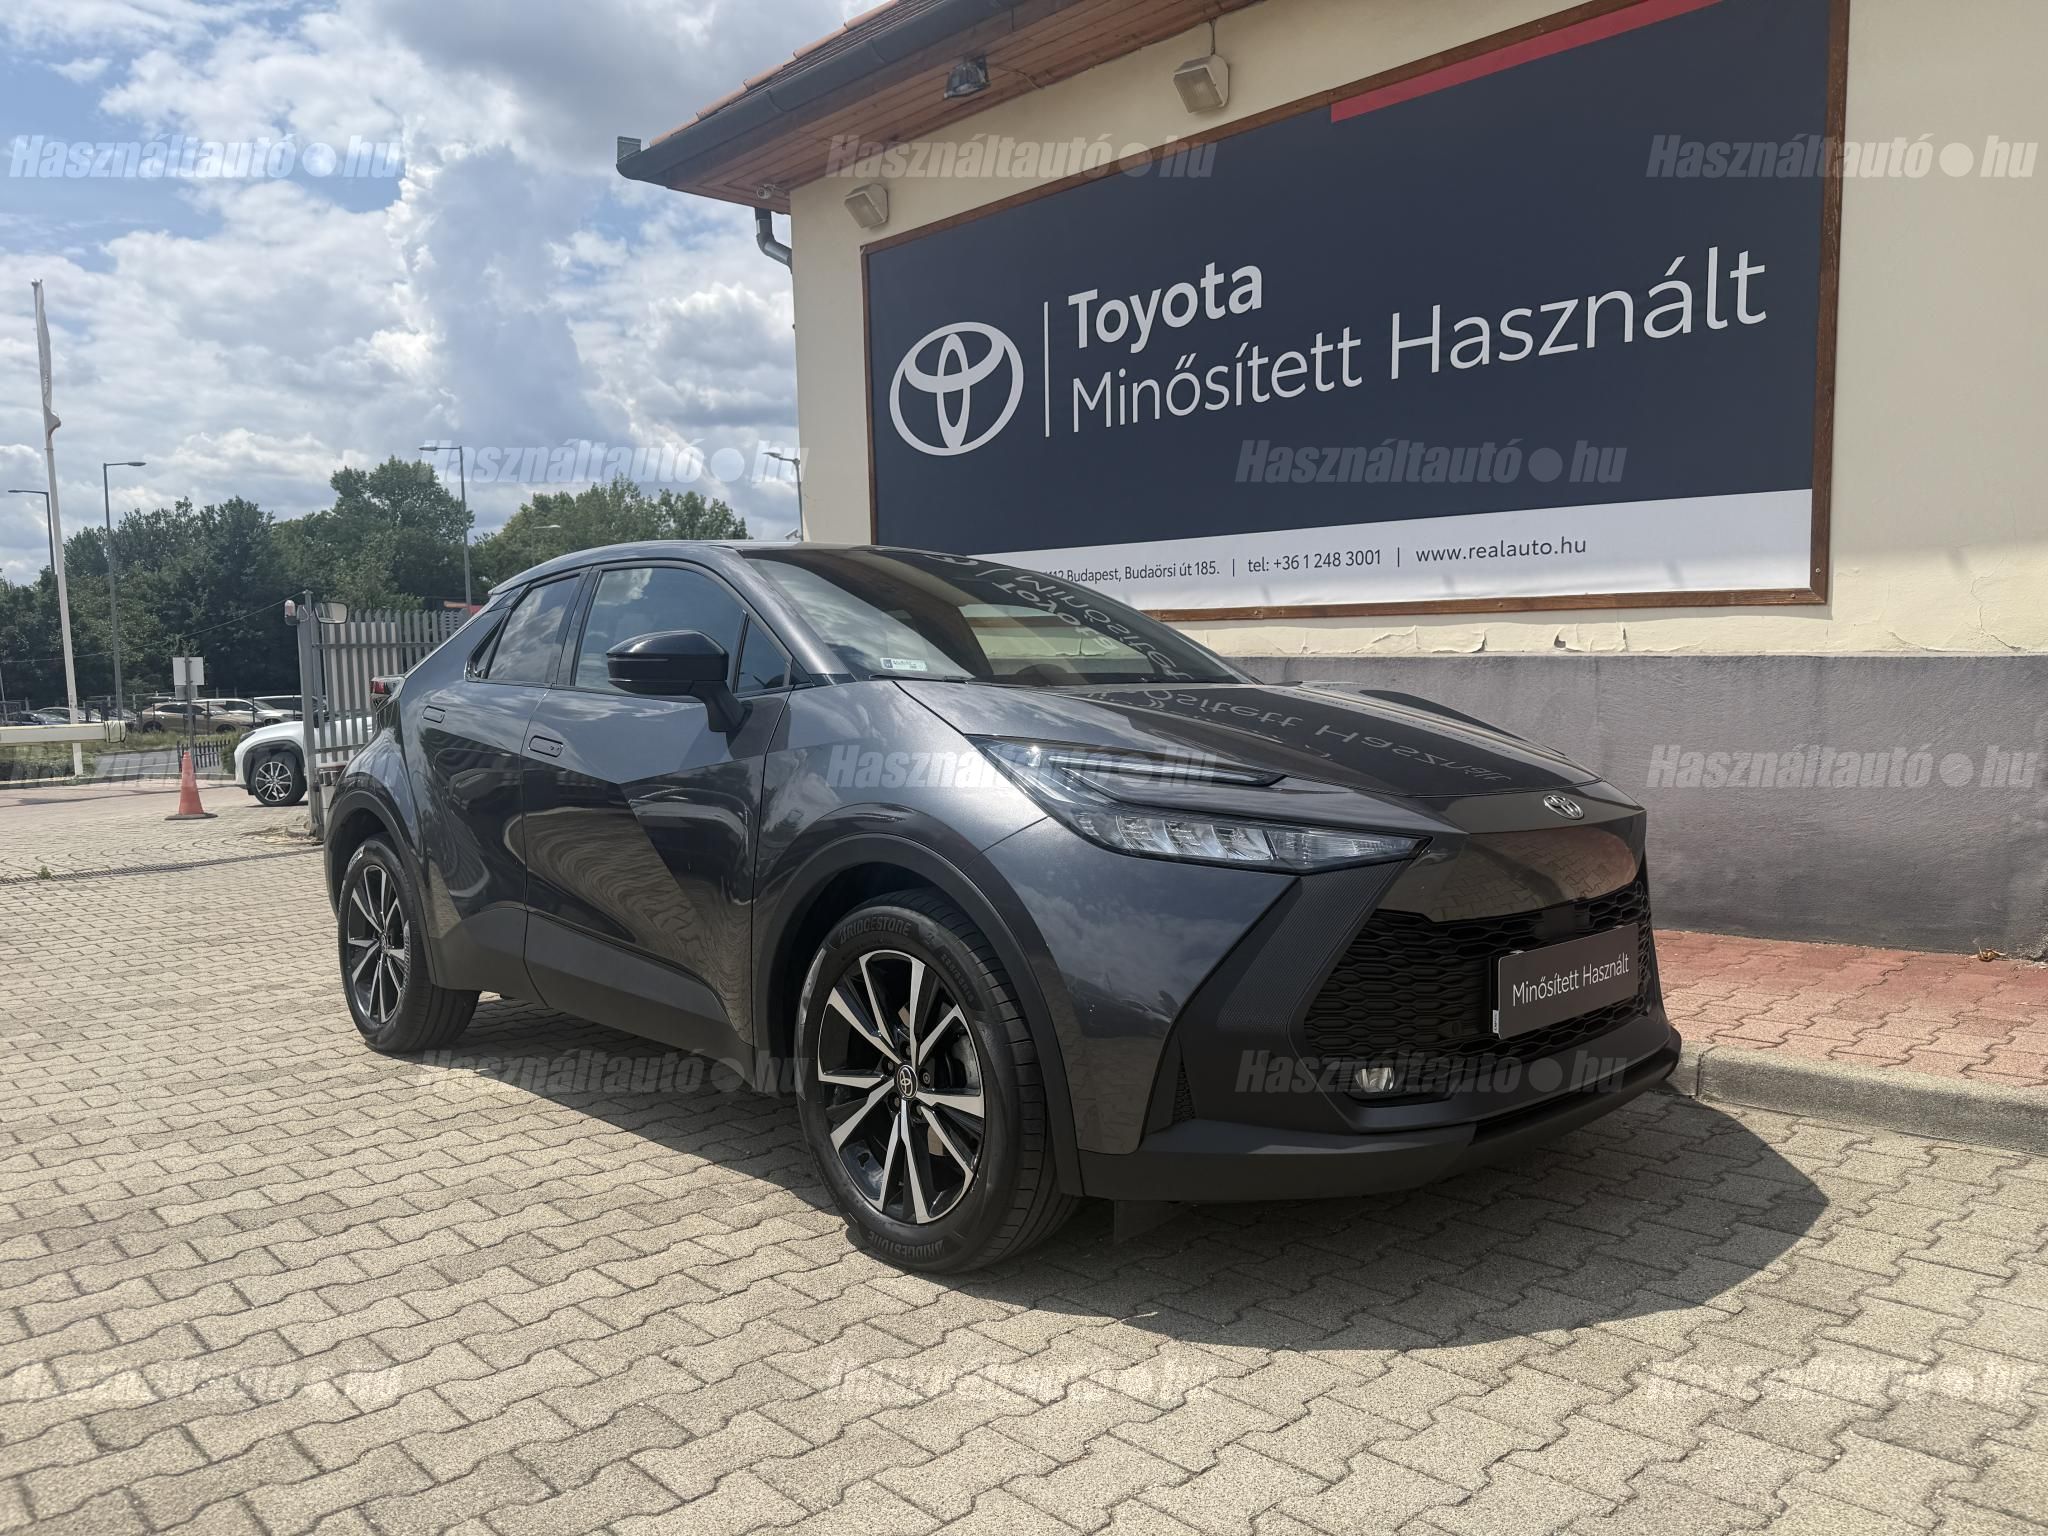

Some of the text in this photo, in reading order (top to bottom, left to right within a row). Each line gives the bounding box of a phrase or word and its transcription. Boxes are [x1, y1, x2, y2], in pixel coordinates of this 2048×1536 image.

[1068, 262, 1263, 353] Toyota
[1072, 246, 1768, 433] Minősített Használt
[1248, 549, 1382, 573] tel: +36 1 248 3001
[1416, 536, 1587, 562] www.realauto.hu
[1125, 564, 1176, 581] Budaörsi
[1179, 562, 1193, 577] út
[1194, 560, 1220, 576] 185.
[1512, 952, 1630, 1007] Minősített Használt
